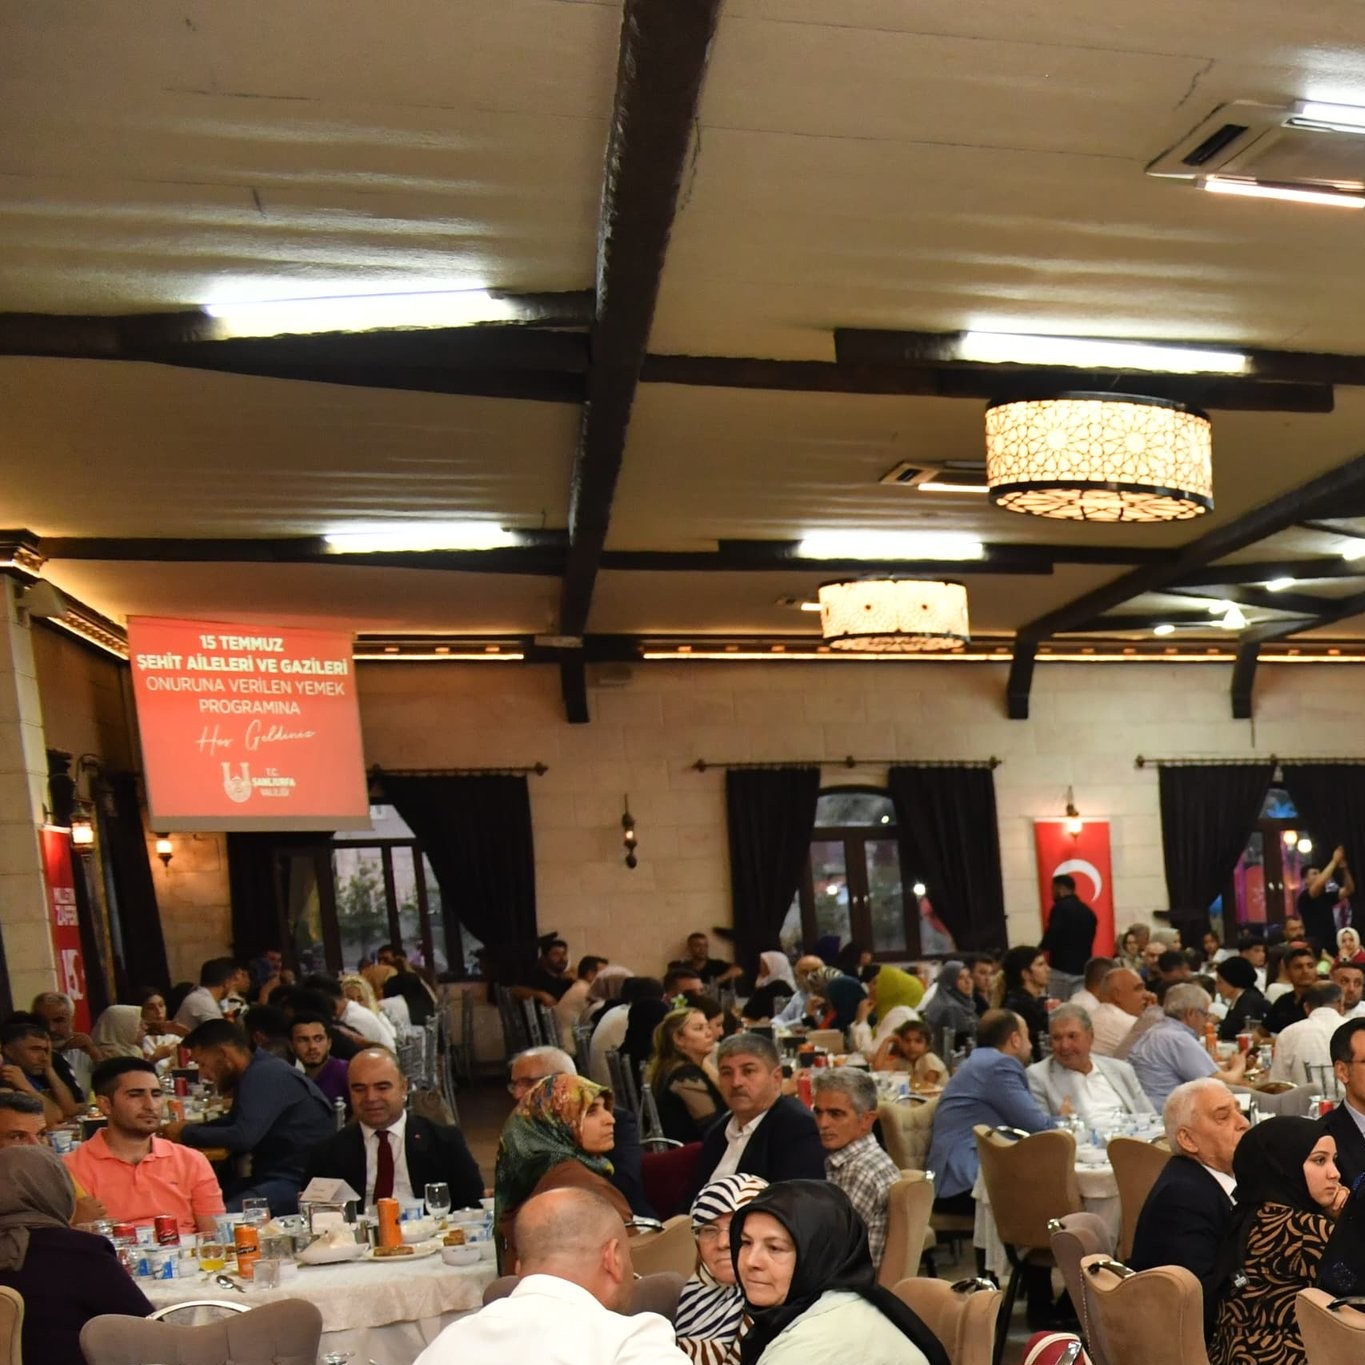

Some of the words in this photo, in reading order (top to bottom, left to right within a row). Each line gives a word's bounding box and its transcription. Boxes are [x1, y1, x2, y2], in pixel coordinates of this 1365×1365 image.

[200, 635, 217, 650] 15
[219, 636, 284, 652] TEMMUZ
[136, 652, 183, 671] ŞEHİT
[187, 653, 254, 672] AİLELERİ
[256, 660, 278, 673] VE
[281, 657, 348, 675] GAZİLERİ
[146, 676, 226, 693] ONURUNA
[228, 677, 293, 694] VERİLEN
[295, 680, 345, 696] YEMEK
[199, 699, 301, 715] PROGRAMINA
